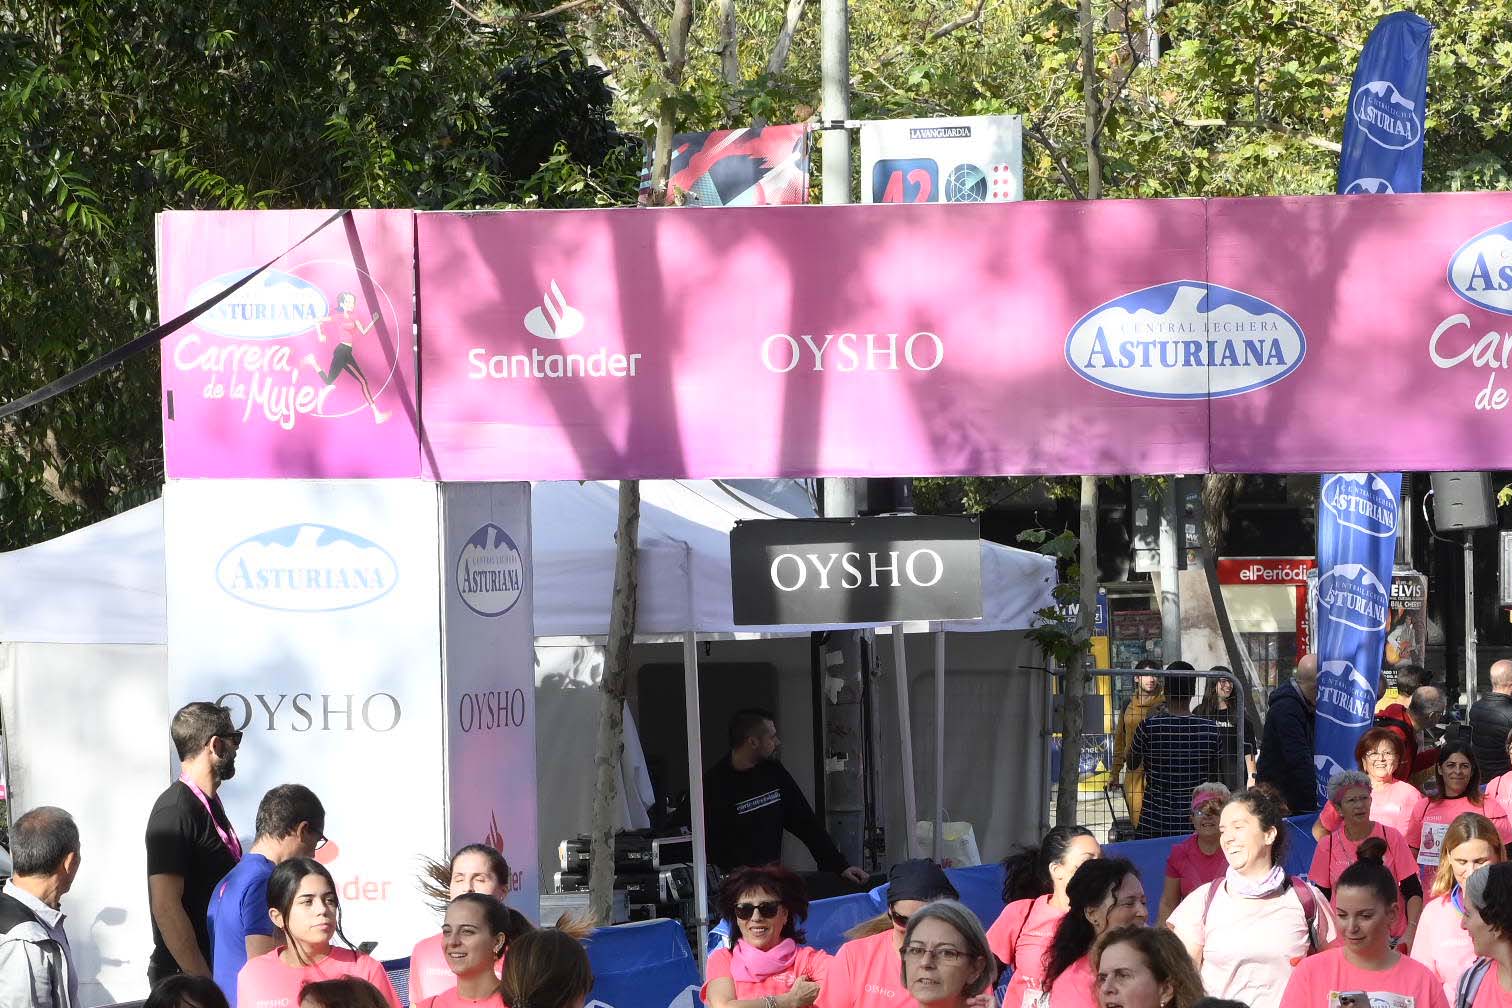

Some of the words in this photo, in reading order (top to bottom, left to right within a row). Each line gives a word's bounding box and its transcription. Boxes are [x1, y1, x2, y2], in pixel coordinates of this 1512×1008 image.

[1120, 321, 1196, 334] CENTRAL
[1205, 320, 1279, 333] LECHERA
[174, 334, 290, 371] Carrera
[468, 348, 642, 378] Santander
[762, 332, 944, 373] OYSHO
[1084, 328, 1288, 369] ASTURIANA
[203, 374, 224, 399] de
[230, 371, 244, 398] la
[243, 368, 336, 431] Mujer
[1475, 372, 1508, 411] de
[231, 556, 385, 591] ASTURIANA
[462, 561, 520, 594] ASTURIANA
[770, 549, 944, 592] OYSHO
[1391, 584, 1421, 597] ELVIS
[213, 692, 402, 733] OYSHO
[459, 689, 526, 733] OYSHO
